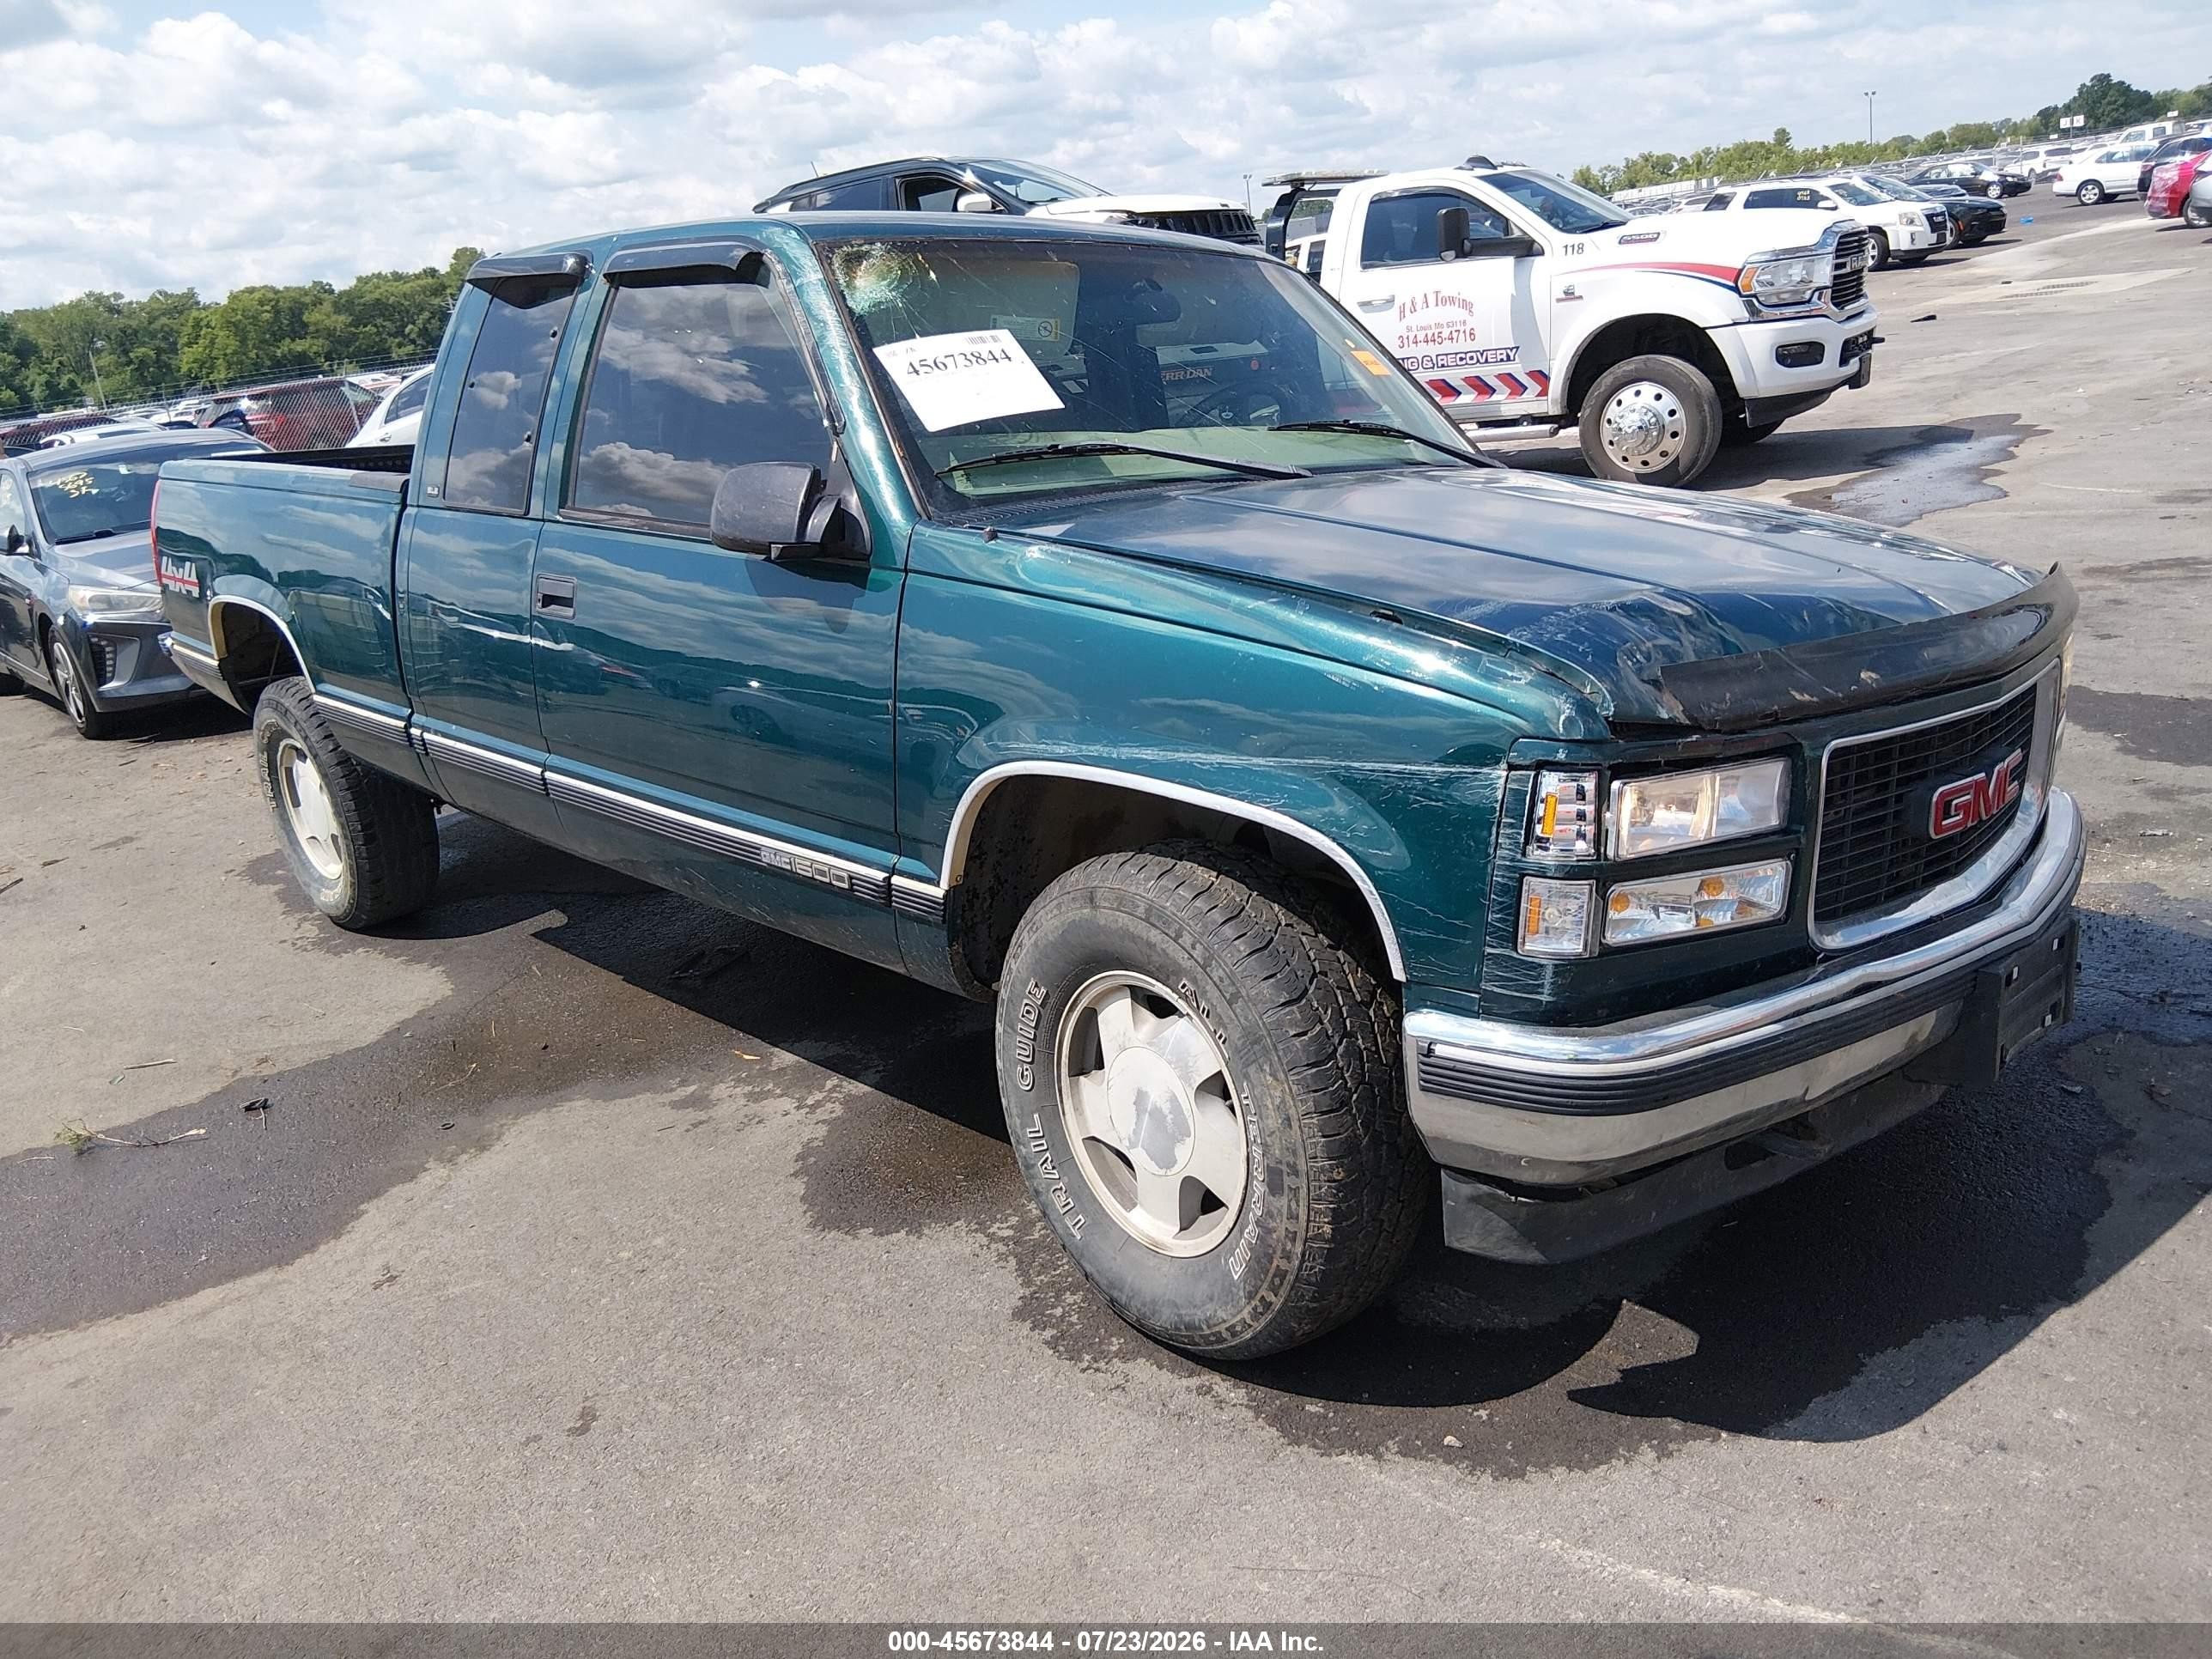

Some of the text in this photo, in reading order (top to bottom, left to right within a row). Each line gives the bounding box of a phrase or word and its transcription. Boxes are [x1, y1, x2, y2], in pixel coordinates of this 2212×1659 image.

[1563, 242, 1584, 256] 118
[1399, 290, 1474, 323] H & A Towing
[1416, 324, 1432, 332] Louis
[1434, 322, 1443, 331] Mo
[907, 349, 1012, 376] 45673844
[1422, 356, 1435, 370] &
[1437, 347, 1519, 368] RECOVERY
[161, 556, 200, 599] 4x4
[1929, 747, 2024, 840] GMC
[1016, 976, 1086, 1243] TRAIL GUIDE
[1229, 1081, 1266, 1280] TERRAIN
